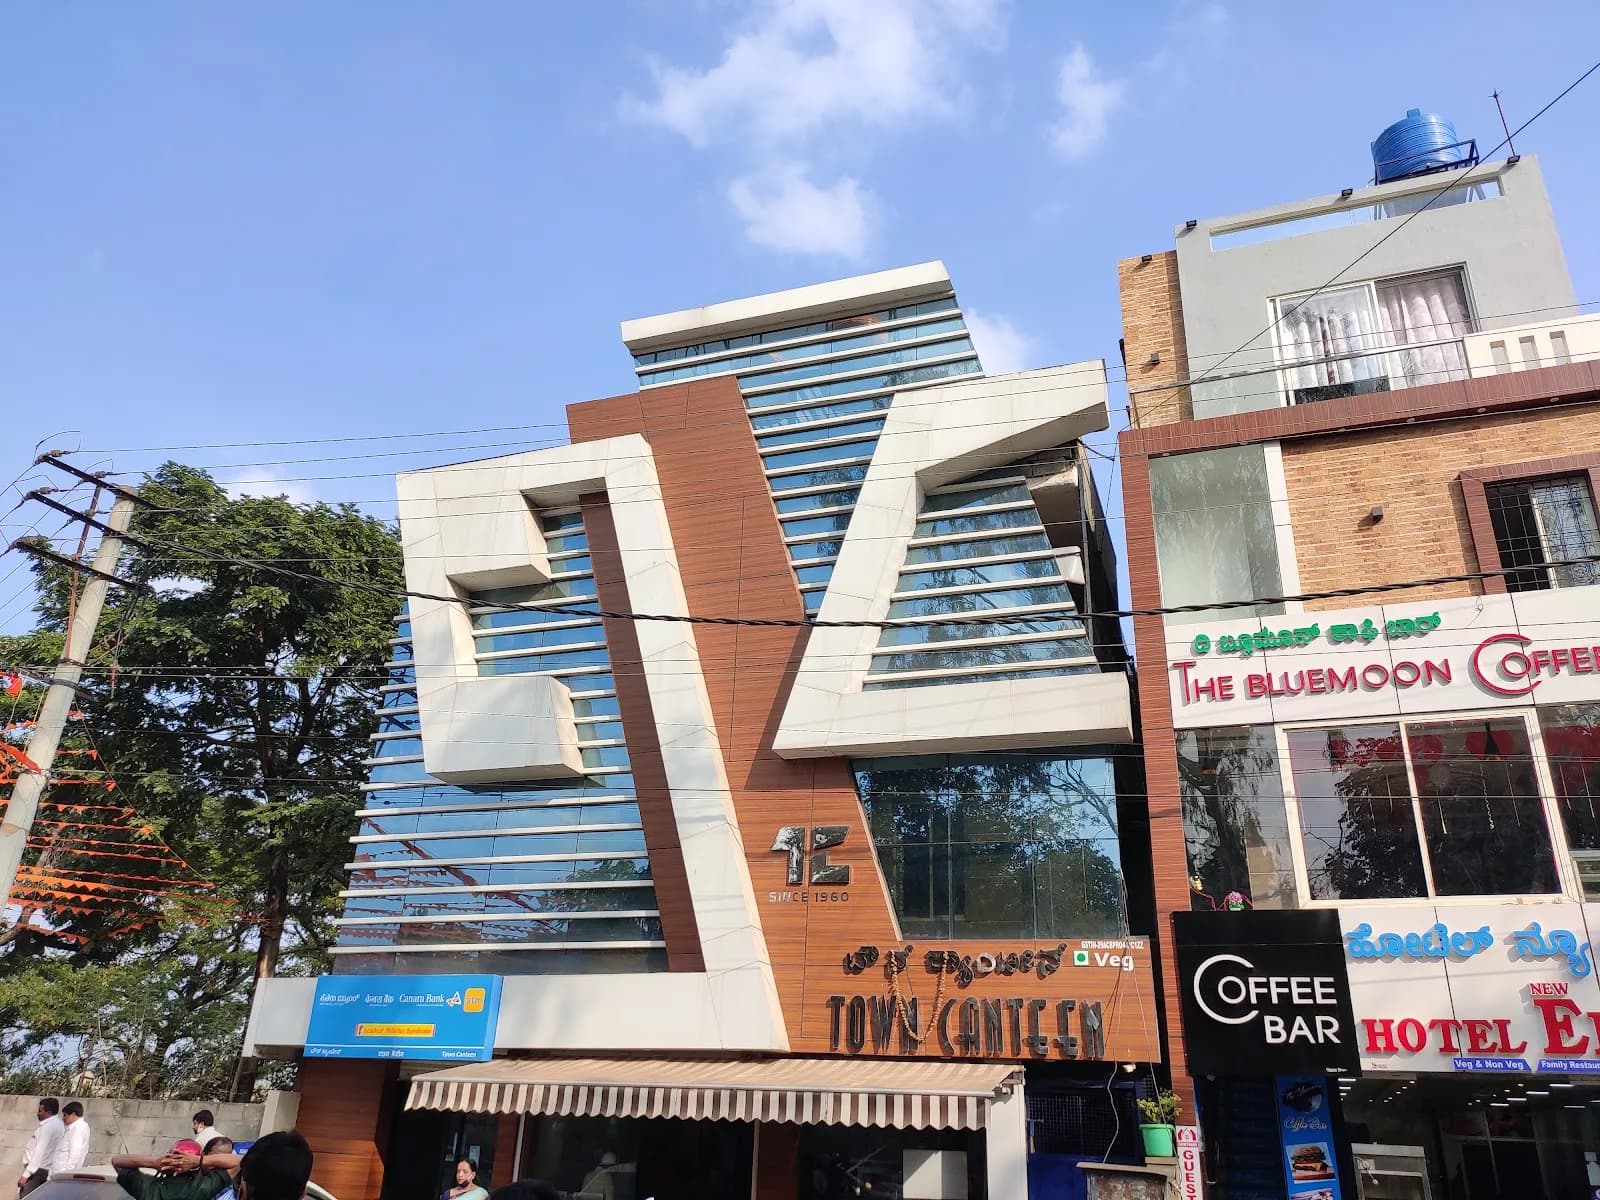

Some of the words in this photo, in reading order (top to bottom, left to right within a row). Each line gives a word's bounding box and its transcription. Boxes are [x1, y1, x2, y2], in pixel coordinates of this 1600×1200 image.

[1249, 658, 1452, 697] BLUEMOON
[768, 891, 808, 903] SINCE
[815, 891, 849, 903] 1960
[1094, 952, 1134, 971] Veg
[400, 993, 425, 1003] Canara
[426, 993, 445, 1003] Bank
[1194, 954, 1337, 1025] COFFEE
[1529, 983, 1568, 995] NEW
[828, 995, 918, 1055] TOWN
[936, 997, 1105, 1058] CANTEEN
[1264, 1015, 1341, 1044] BAR
[1361, 1018, 1528, 1053] HOTEL
[1454, 1060, 1473, 1070] Veg
[1475, 1060, 1483, 1068] &
[1485, 1060, 1503, 1068] Non
[1505, 1060, 1524, 1070] Veg
[1542, 1060, 1568, 1070] Family
